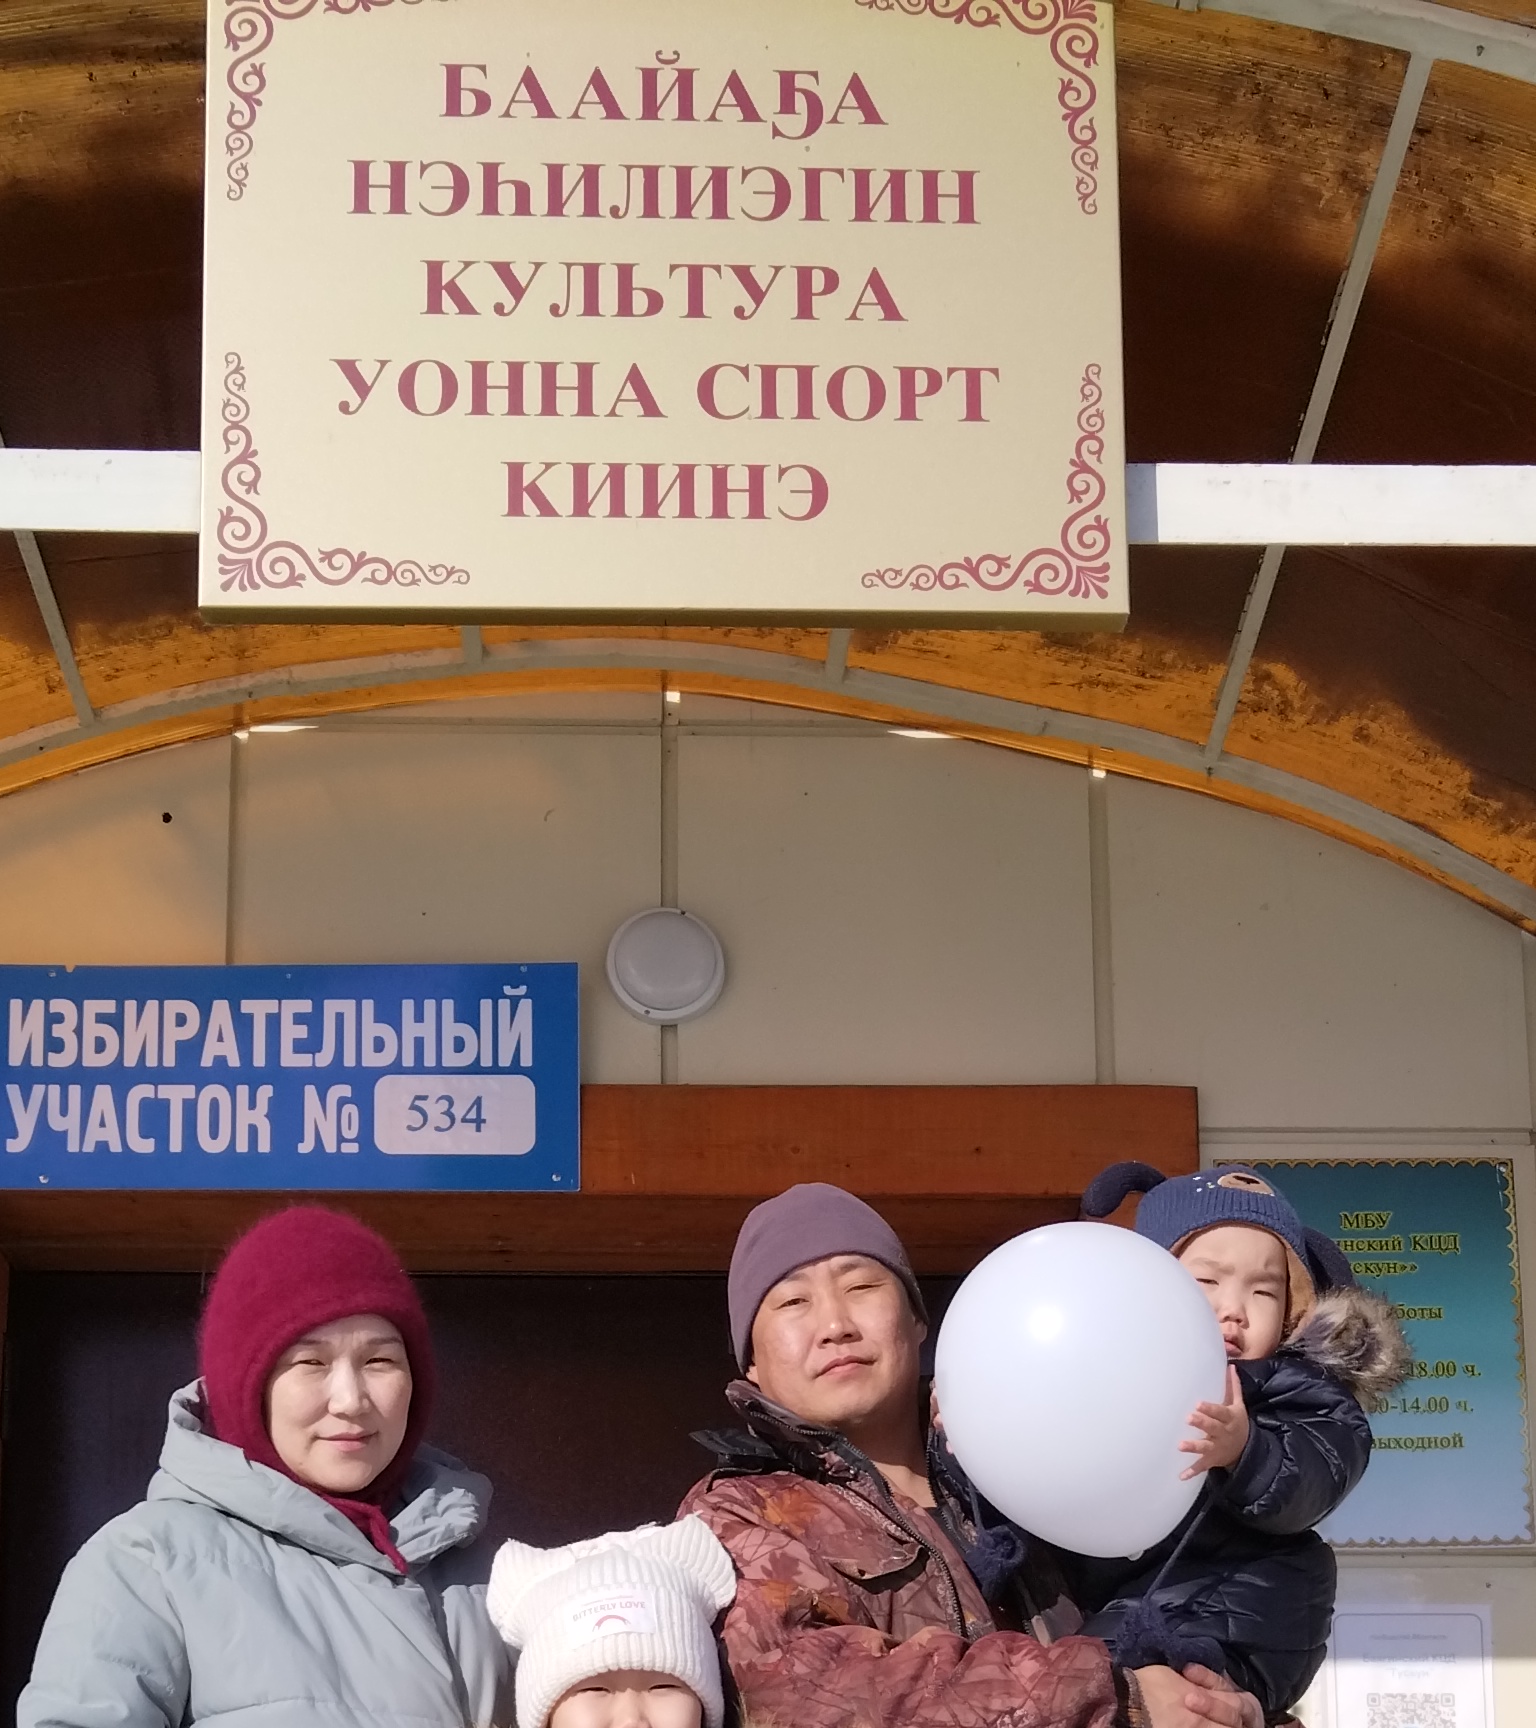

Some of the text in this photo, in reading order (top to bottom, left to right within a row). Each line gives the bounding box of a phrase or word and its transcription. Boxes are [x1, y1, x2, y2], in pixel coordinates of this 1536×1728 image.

[439, 51, 888, 141] БААЙАҔА
[419, 259, 908, 322] КУЛЬТУРА
[330, 357, 1001, 424] УОННА СПОРТ
[500, 460, 830, 522] КИИНЭ
[7, 985, 533, 1068] ИЗБИРАТЕЛЬНЫЙ
[5, 1083, 487, 1154] УЧАСТОК № 534
[1335, 1232, 1461, 1255] нский КЦД
[1339, 1211, 1392, 1230] МБУ
[1390, 1303, 1444, 1320] боты
[1464, 1363, 1483, 1378] ч.
[619, 1600, 646, 1609] LOVE
